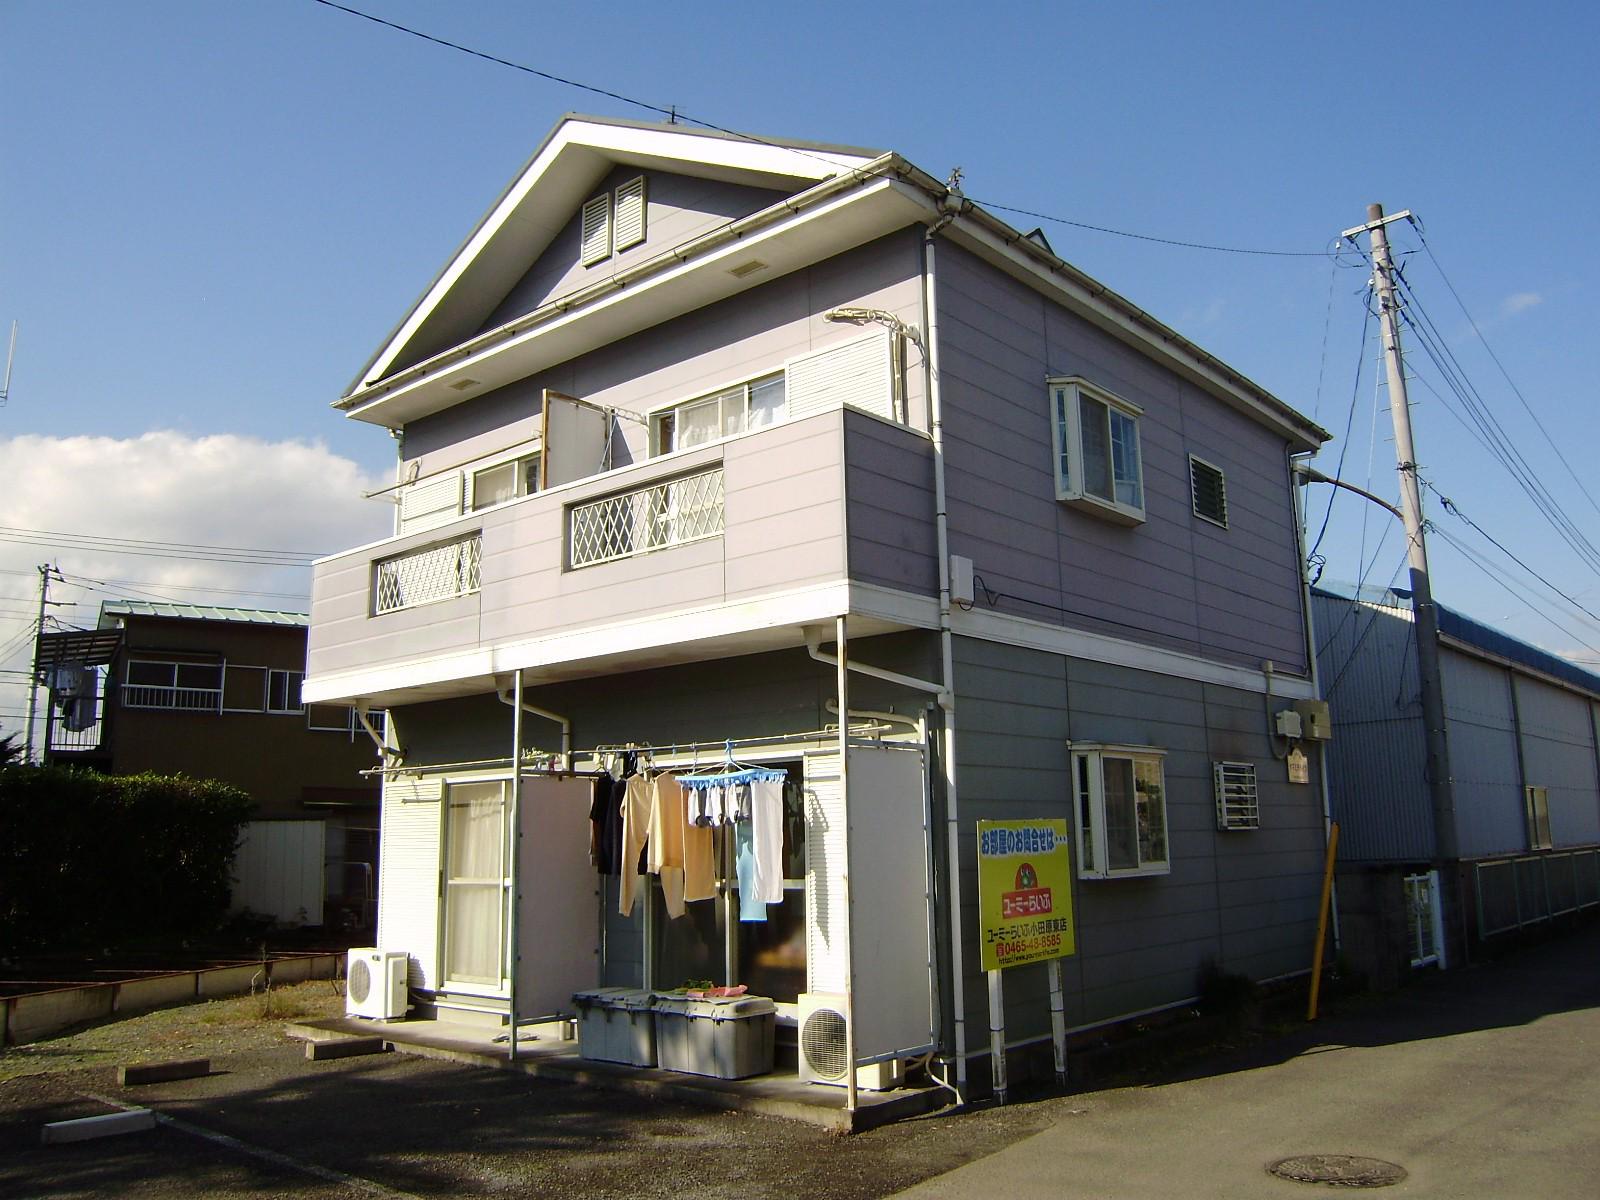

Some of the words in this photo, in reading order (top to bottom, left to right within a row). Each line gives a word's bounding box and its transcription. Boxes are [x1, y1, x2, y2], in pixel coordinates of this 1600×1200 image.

[1003, 894, 1051, 914] ユーミーらいふ
